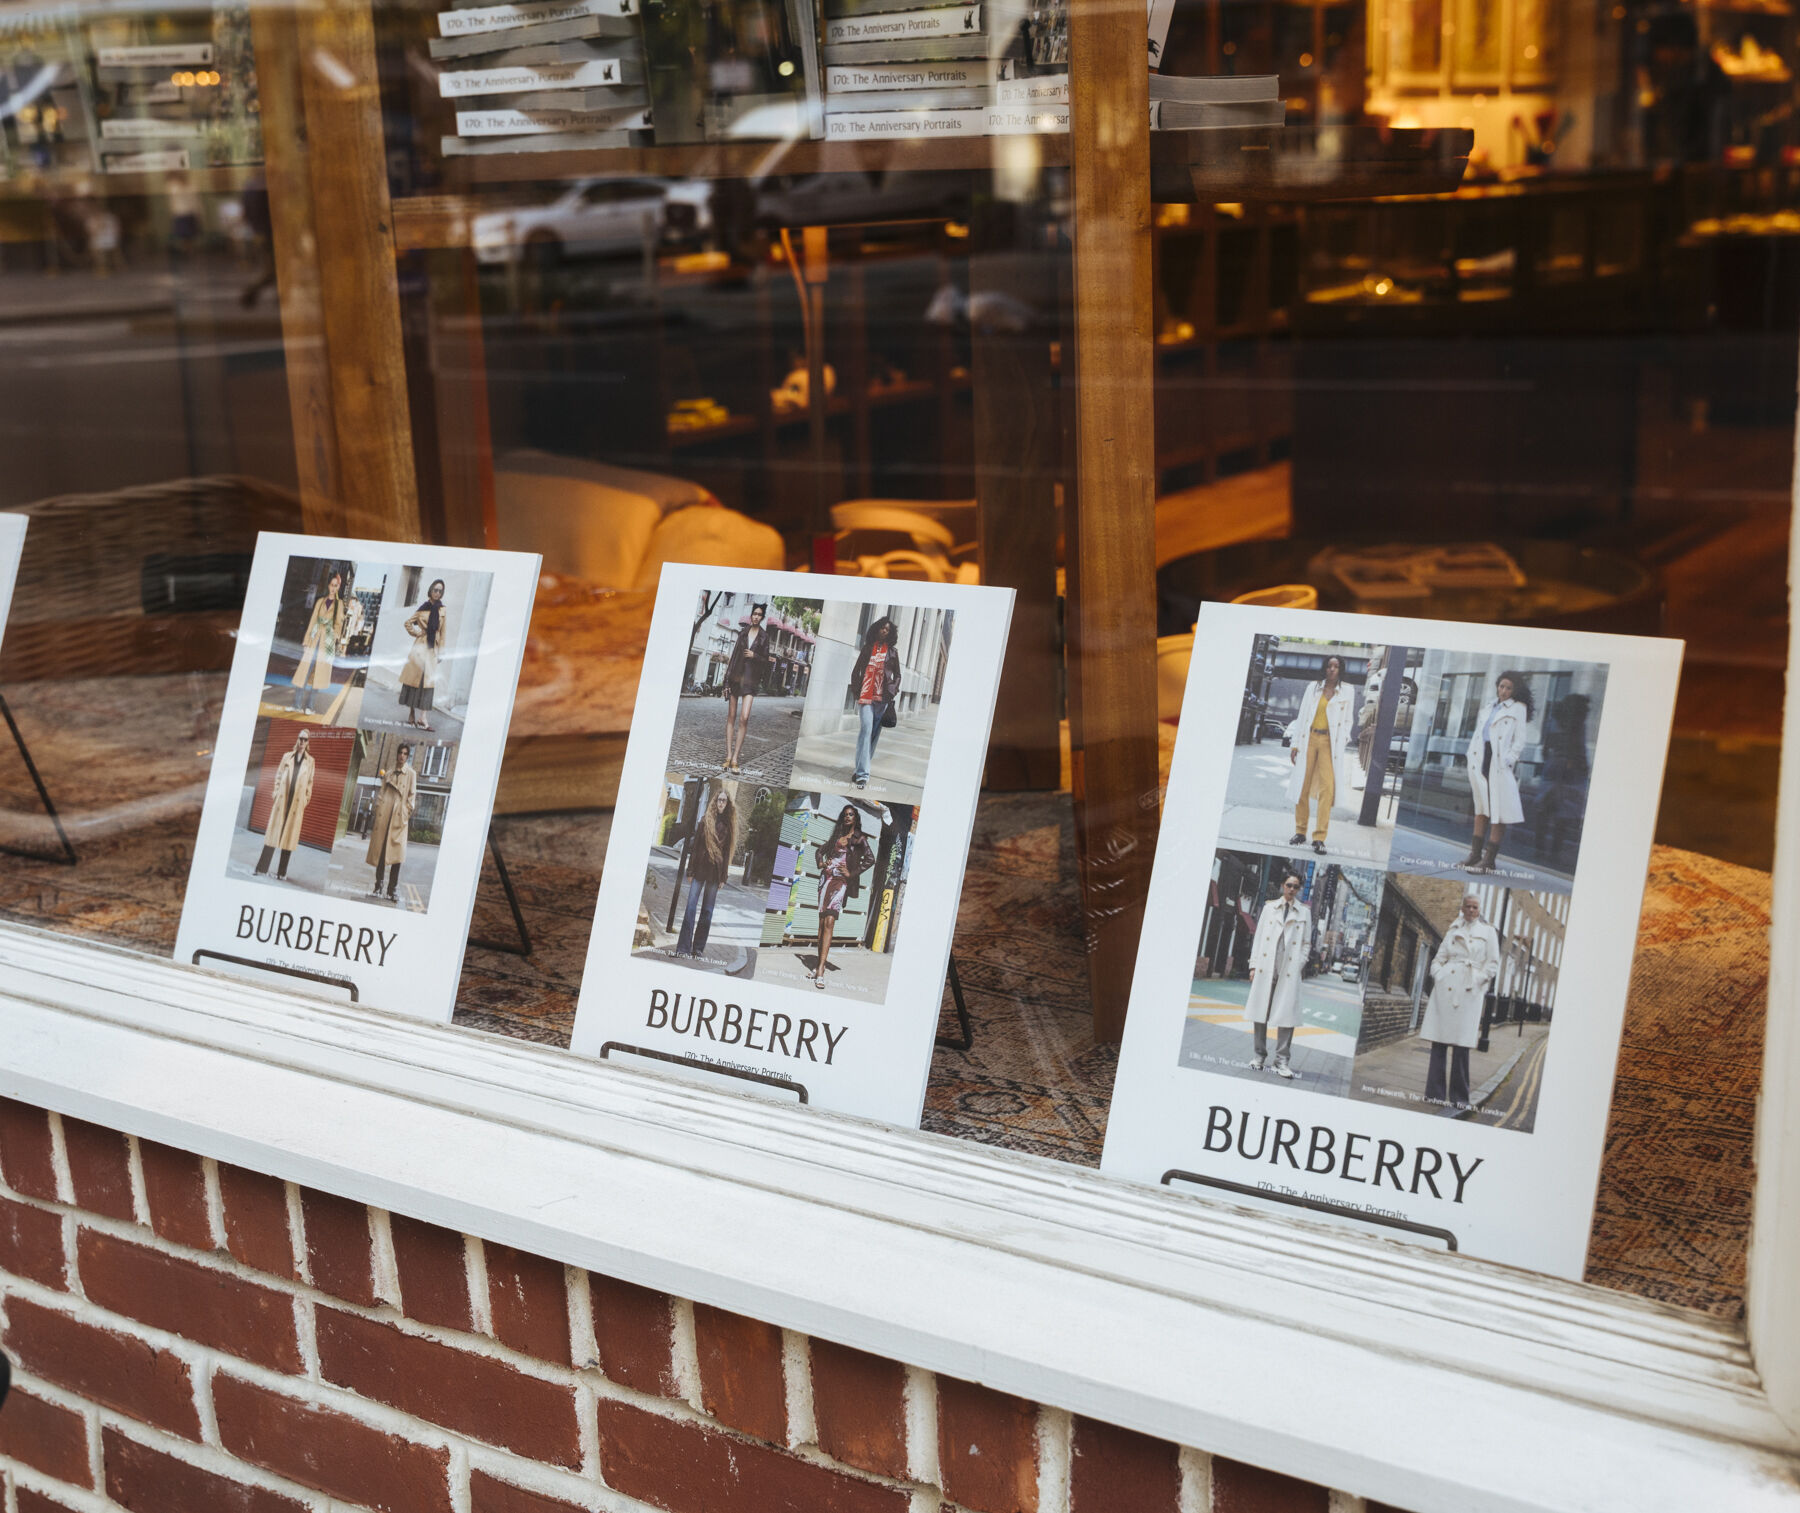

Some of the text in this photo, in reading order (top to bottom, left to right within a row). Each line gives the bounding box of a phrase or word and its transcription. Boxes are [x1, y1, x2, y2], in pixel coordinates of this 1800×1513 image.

[468, 16, 485, 27] The
[832, 17, 940, 38] 170: The Anniversary Portraits
[465, 79, 481, 88] The
[484, 76, 535, 87] Anniversary
[834, 70, 967, 86] 170: The Anniversary Portraits
[487, 118, 506, 128] The
[831, 118, 962, 134] 170: The Anniversary Portraits
[1007, 114, 1022, 126] The
[236, 904, 398, 967] BURBERRY
[646, 989, 848, 1065] BURBERRY
[700, 1054, 714, 1062] The
[716, 1058, 760, 1074] Anniversary
[762, 1068, 792, 1081] Portraits
[1409, 1092, 1420, 1101] The
[1202, 1105, 1484, 1204] BURBERRY
[1279, 1185, 1298, 1196] The
[1302, 1190, 1362, 1211] Anniversary
[1366, 1204, 1408, 1222] Portraits
